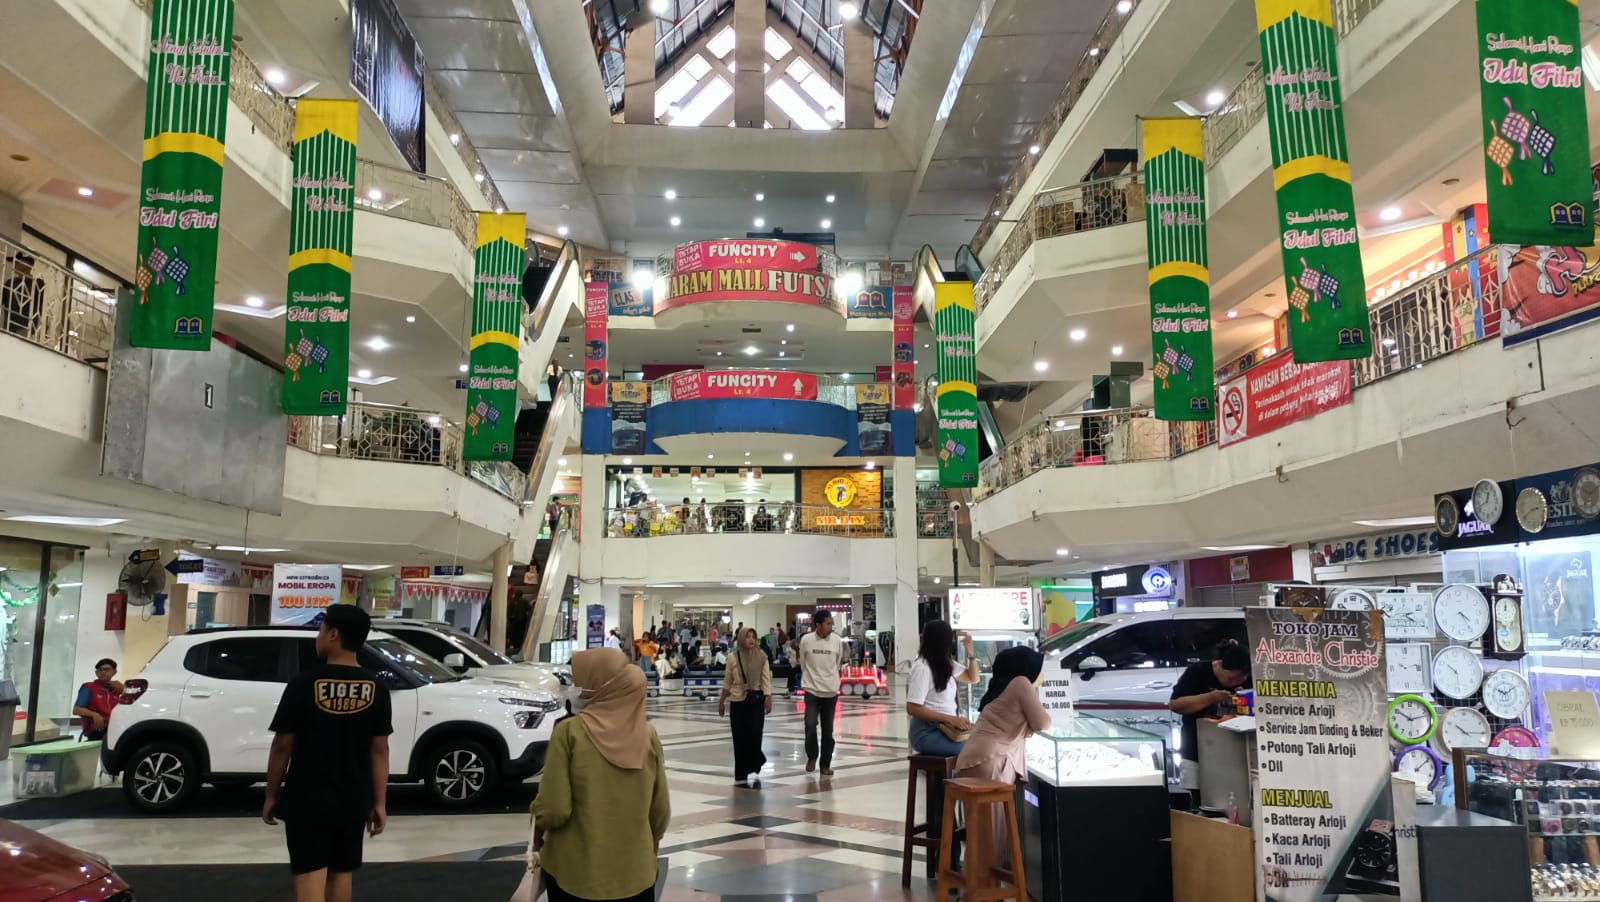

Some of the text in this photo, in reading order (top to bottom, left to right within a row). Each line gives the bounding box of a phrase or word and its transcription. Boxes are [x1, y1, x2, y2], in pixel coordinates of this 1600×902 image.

[1483, 58, 1581, 89] Idul Fitri
[140, 207, 217, 230] Idul Fitri
[1284, 228, 1356, 249] Idul Fitri
[708, 243, 778, 257] FUNCITY
[678, 252, 701, 267] BUKA
[718, 268, 765, 292] MALL
[288, 306, 348, 323] Idul Fitri
[1153, 317, 1208, 333] Idul Fitri
[676, 373, 698, 385] TETAP
[707, 374, 778, 388] FUNCITY
[1251, 367, 1280, 395] KAWASAN
[677, 382, 699, 395] BUKA
[1457, 520, 1494, 538] JAGUAR
[1344, 530, 1439, 560] BG SHOES
[278, 582, 336, 590] MOBIL EROPA
[1272, 622, 1358, 638] TOKO JAM
[1255, 637, 1379, 668] Alexandre Christie
[318, 682, 373, 701] EIGER
[1045, 690, 1066, 698] HARGA
[1256, 679, 1337, 698] MENERIMA
[331, 698, 355, 711] 1989
[1265, 703, 1336, 719] Service Arloji
[1266, 722, 1383, 739] Service Jam Dinding & Beker
[1267, 741, 1357, 759] Potong Tali Arloji
[1262, 788, 1332, 808] MENJUAL
[1271, 813, 1347, 830] Batteray Arloji
[1272, 833, 1330, 849] Kaca Arloji
[1273, 852, 1323, 868] Tali Arloji
